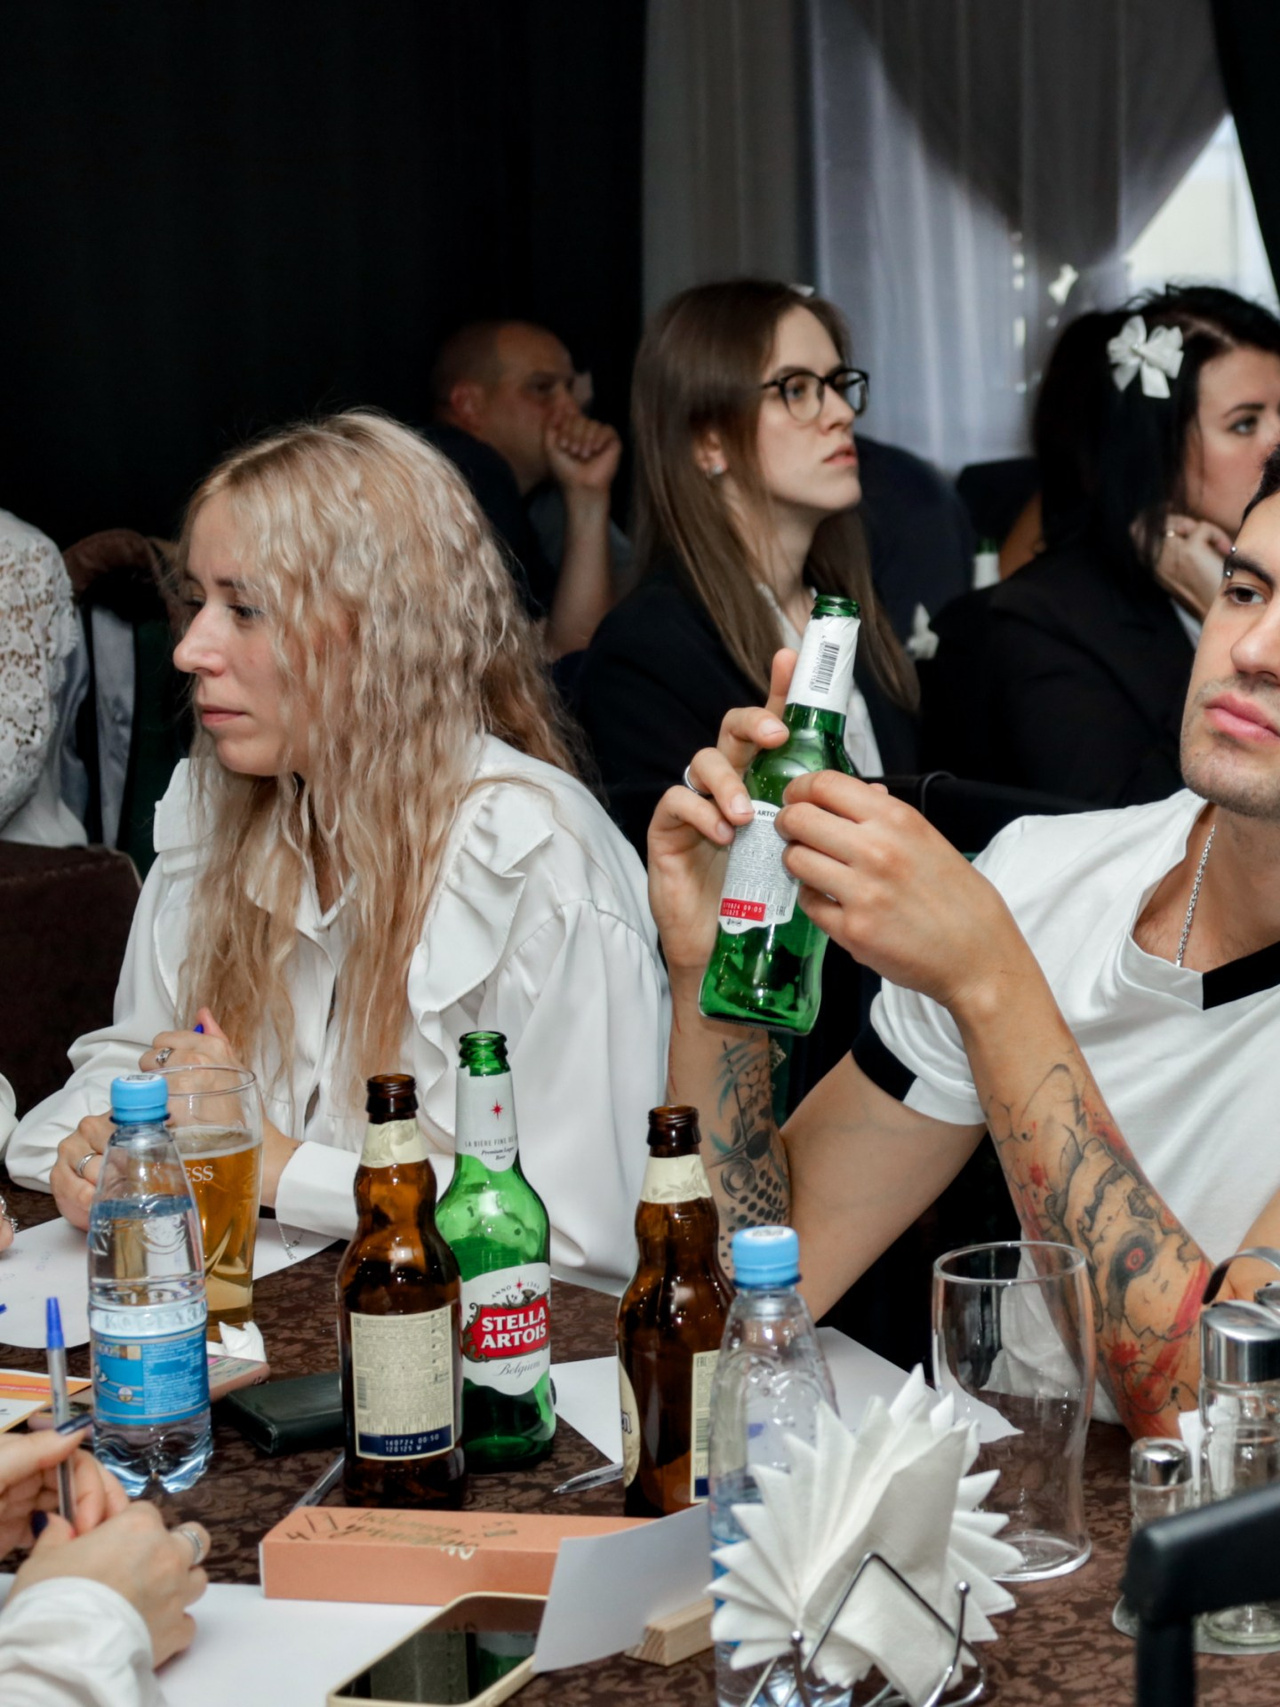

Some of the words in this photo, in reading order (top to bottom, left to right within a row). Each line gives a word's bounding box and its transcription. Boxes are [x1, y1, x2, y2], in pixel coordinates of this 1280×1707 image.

[756, 809, 778, 818] ARTO
[491, 1285, 512, 1299] ANNO
[481, 1306, 546, 1332] STELLA
[480, 1323, 547, 1349] ARTOIS
[494, 1360, 542, 1379] Belgium
